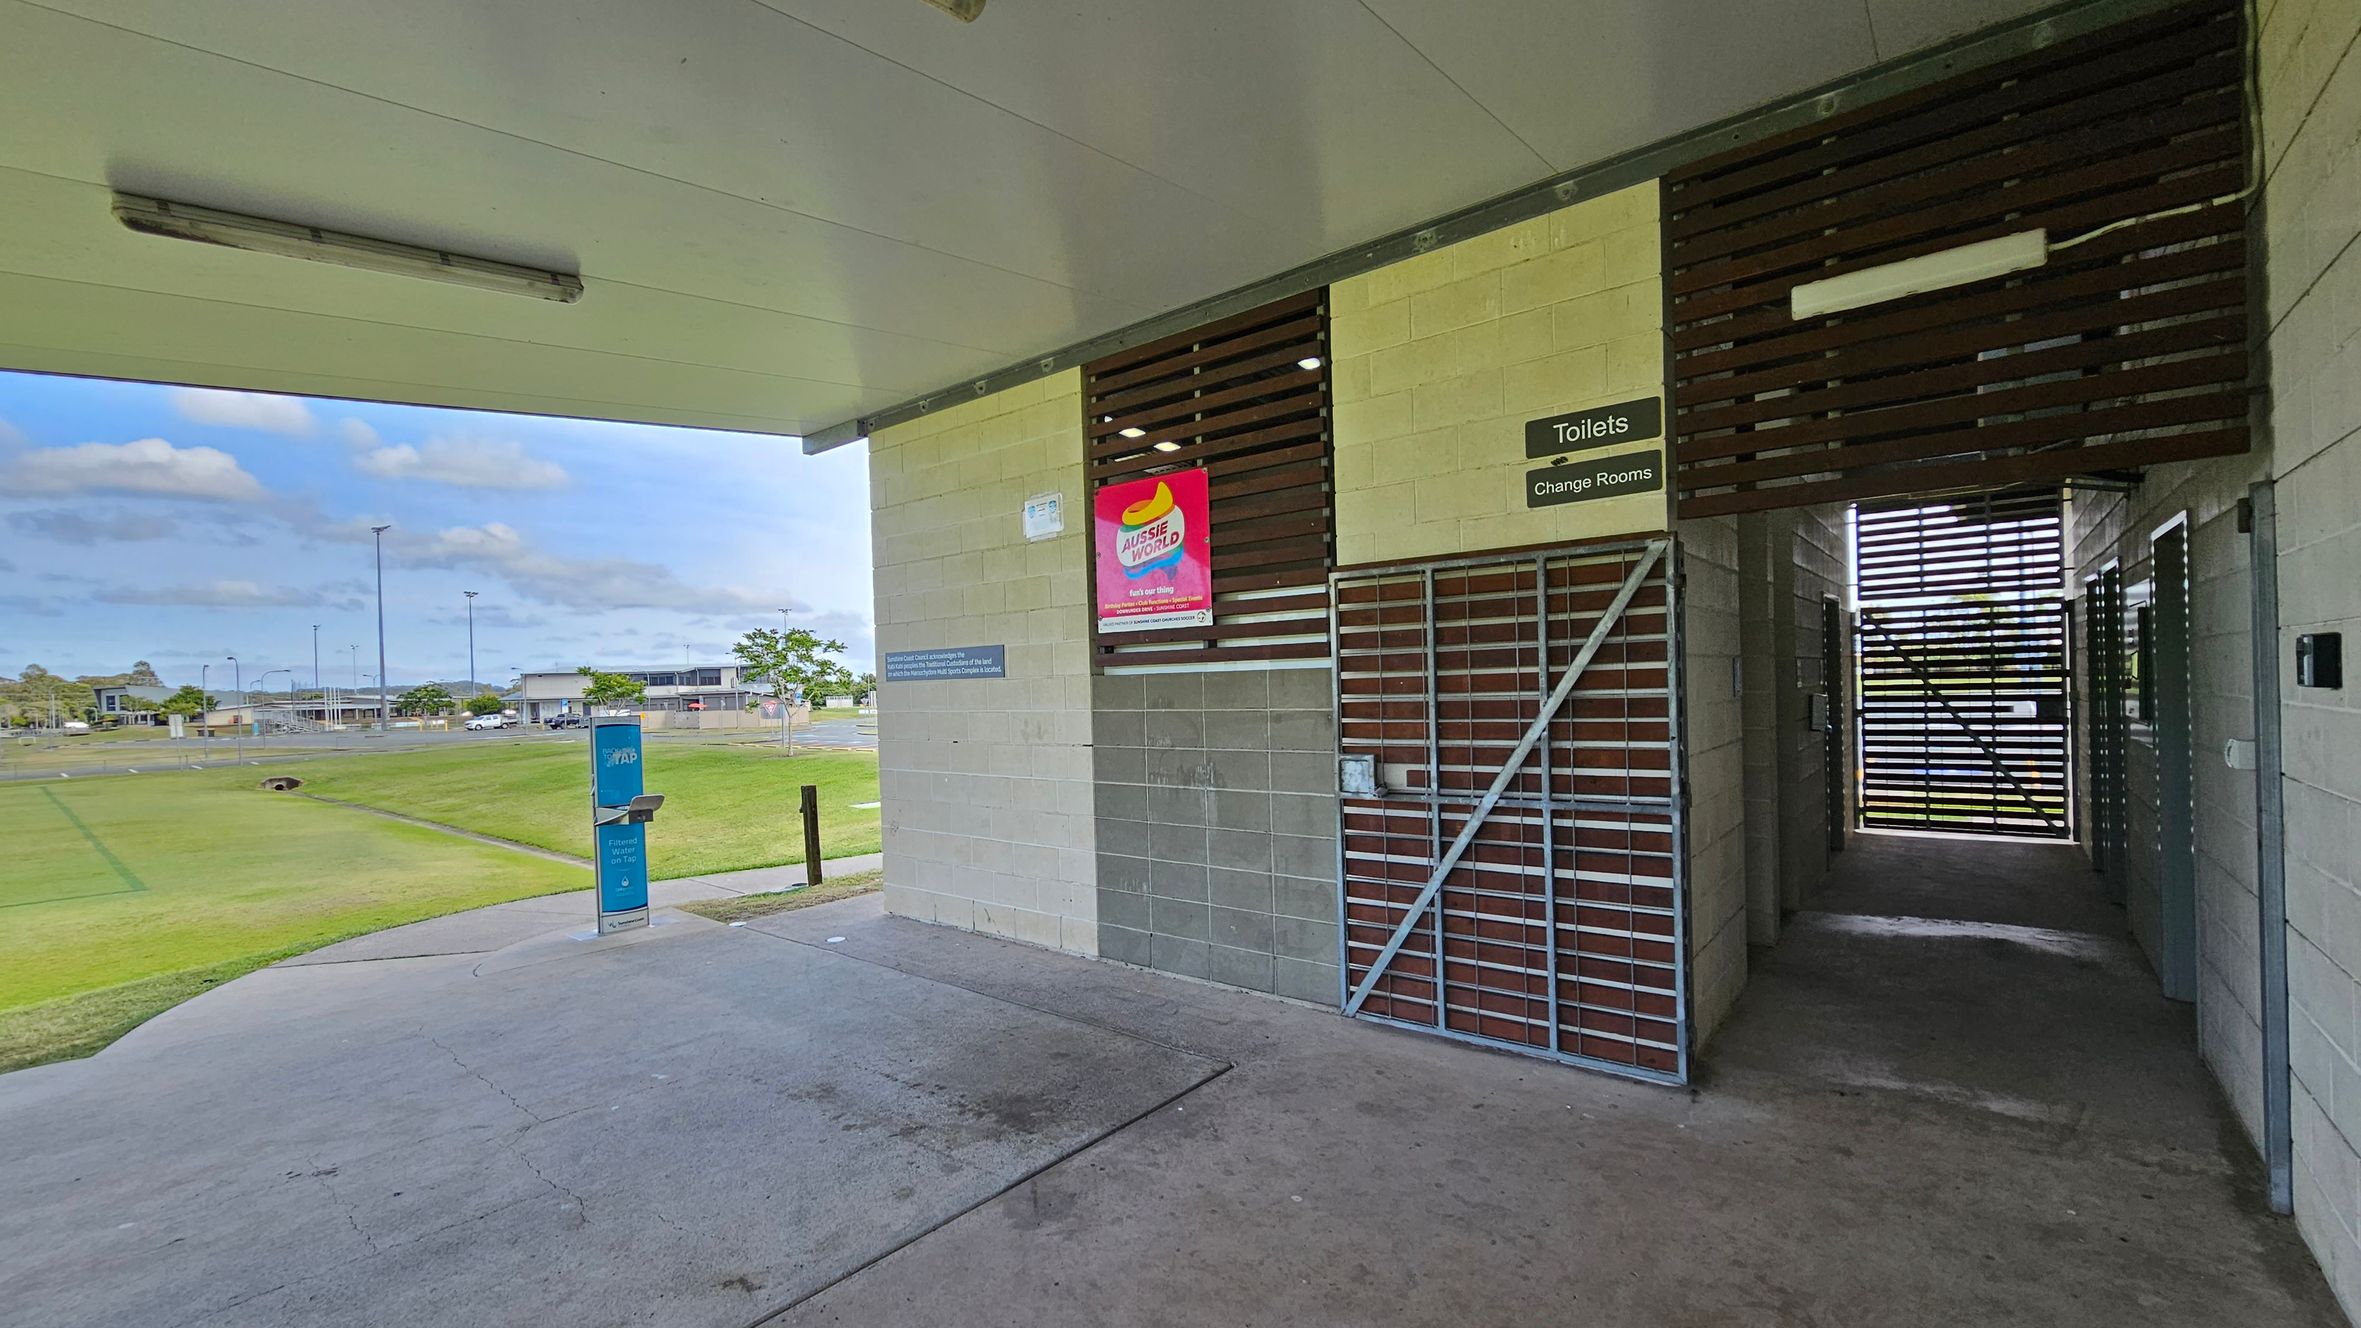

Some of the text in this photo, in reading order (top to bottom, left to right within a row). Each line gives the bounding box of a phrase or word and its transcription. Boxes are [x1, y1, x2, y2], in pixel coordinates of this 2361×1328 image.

[1553, 415, 1629, 444] Toilets
[1535, 468, 1653, 496] Change Rooms
[1121, 520, 1169, 553] AUSSIE
[1132, 531, 1180, 562] WORLD
[1129, 586, 1174, 597] fun's our thing
[982, 657, 992, 665] land
[609, 837, 638, 846] Filtered
[612, 847, 635, 856] Water
